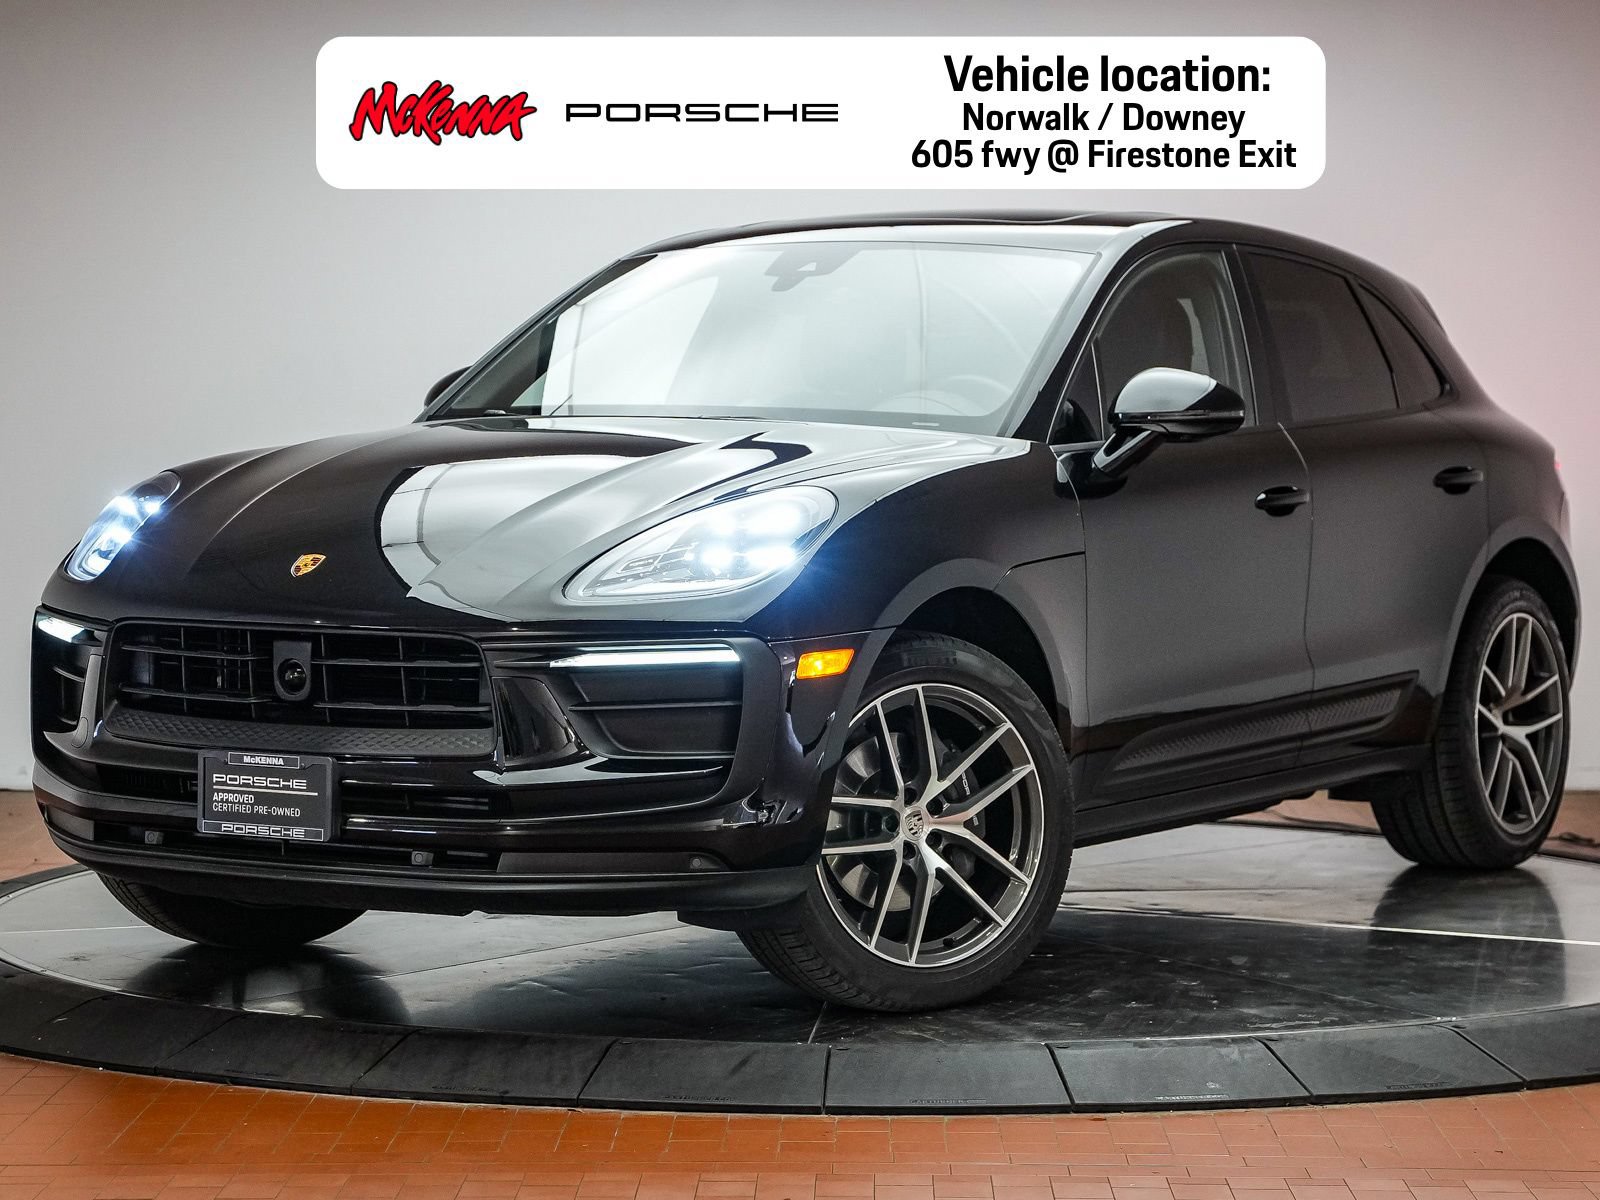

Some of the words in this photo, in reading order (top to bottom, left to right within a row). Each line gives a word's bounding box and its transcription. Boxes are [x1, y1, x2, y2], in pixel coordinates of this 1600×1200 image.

[243, 755, 285, 766] McKENNA
[213, 774, 307, 789] PORSCHE
[212, 792, 255, 803] APPROVED
[212, 803, 251, 813] CERTIFIED
[253, 805, 301, 817] PRE-OWNED
[222, 824, 305, 837] PORSCHE
